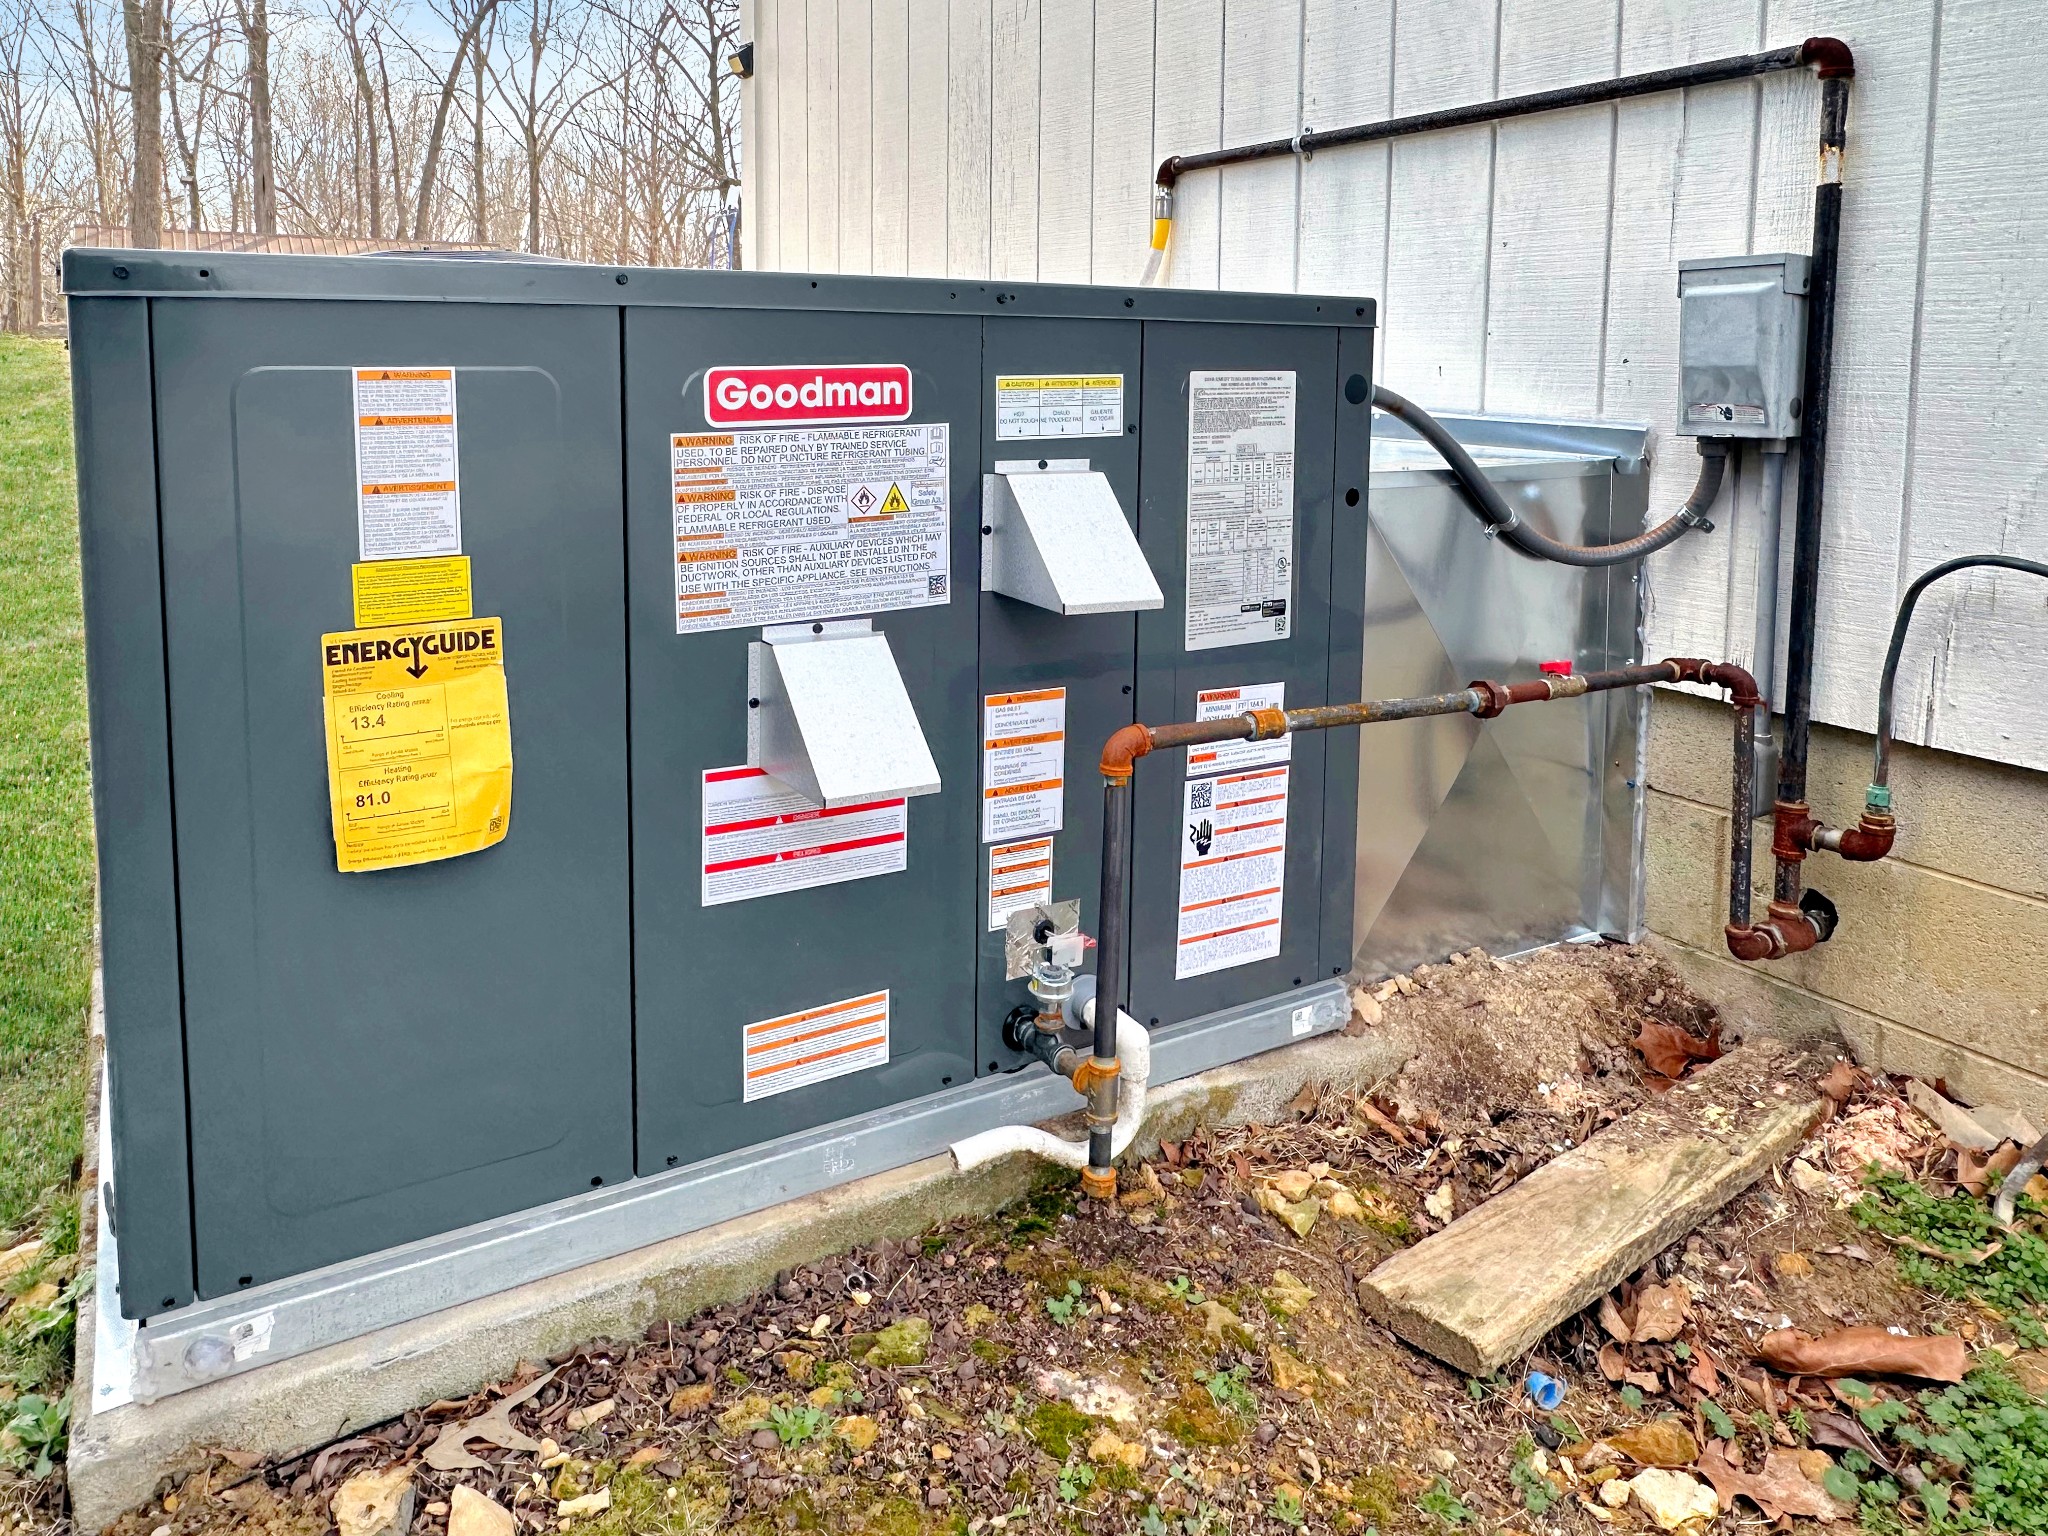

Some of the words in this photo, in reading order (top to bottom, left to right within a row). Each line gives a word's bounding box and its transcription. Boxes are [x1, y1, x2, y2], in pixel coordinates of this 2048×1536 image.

[716, 375, 903, 411] Goodman
[686, 436, 733, 447] WARNING
[739, 435, 761, 445] RISK
[764, 434, 776, 444] OF
[779, 433, 800, 443] FIRE
[807, 431, 861, 442] FLAMMABLE
[862, 428, 922, 440] REFRIGERANT
[676, 448, 707, 458] USED.
[709, 447, 723, 457] TO
[725, 446, 738, 456] BE
[740, 445, 788, 455] REPAIRED
[790, 443, 814, 453] ONLY
[816, 443, 828, 452] BY
[830, 441, 869, 451] TRAINED
[870, 439, 907, 449] SERVICE
[676, 456, 739, 468] PERSONNEL.
[741, 455, 755, 465] DO
[757, 454, 777, 464] NOT
[779, 452, 829, 463] PUNCTURE
[831, 449, 893, 461] REFRIGERANT
[687, 491, 735, 502] WARNING
[740, 490, 762, 500] RISK
[764, 489, 777, 499] OF
[779, 488, 800, 498] FIRE
[807, 485, 846, 496] DISPOSE
[676, 504, 691, 514] OF
[693, 501, 745, 513] PROPERLY
[747, 500, 757, 509] IN
[759, 496, 824, 508] ACCORDANCE
[824, 494, 848, 504] WITH
[677, 512, 722, 524] FEDERAL
[726, 511, 741, 521] OR
[742, 509, 773, 520] LOCAL
[775, 505, 841, 518] REGULATIONS.
[677, 523, 736, 535] FLAMMABLE
[739, 518, 804, 530] REFRIGERANT
[806, 516, 832, 526] USED.
[689, 550, 737, 561] WARNING
[742, 548, 764, 558] RISK
[766, 547, 779, 556] OF
[781, 545, 802, 555] FIRE
[810, 540, 855, 552] AUXILIARY
[857, 537, 894, 548] DEVICES
[895, 534, 924, 545] WHICH
[925, 532, 942, 542] MAY
[680, 563, 694, 573] BE
[696, 560, 739, 572] IGNITION
[740, 556, 787, 568] SOURCES
[789, 553, 818, 564] SHALL
[819, 551, 838, 561] NOT
[840, 550, 851, 559] BE
[854, 545, 899, 558] INSTALLED
[901, 544, 910, 552] IN
[911, 543, 928, 552] THE
[680, 570, 740, 583] DUCTWORK,
[742, 566, 775, 577] OTHER
[777, 564, 802, 574] THAN
[803, 559, 849, 571] AUXILIARY
[851, 556, 888, 567] DEVICES
[890, 553, 919, 564] LISTED
[921, 551, 937, 561] FOR
[681, 584, 701, 594] USE
[703, 582, 729, 592] WITH
[731, 579, 750, 589] THE
[752, 575, 795, 587] SPECIFIC
[849, 568, 867, 578] SEE
[325, 629, 496, 667] ENERGYGUIDE
[376, 691, 404, 701] Cooling
[349, 703, 385, 713] Efficiency
[386, 700, 410, 709] Rating
[350, 713, 386, 731] 13.4
[384, 765, 412, 775] Heating
[358, 777, 394, 788] Efficiency
[396, 774, 420, 783] Rating
[355, 791, 391, 808] 81.0
[793, 811, 820, 821] DANGER
[793, 848, 821, 858] PELIGRO
